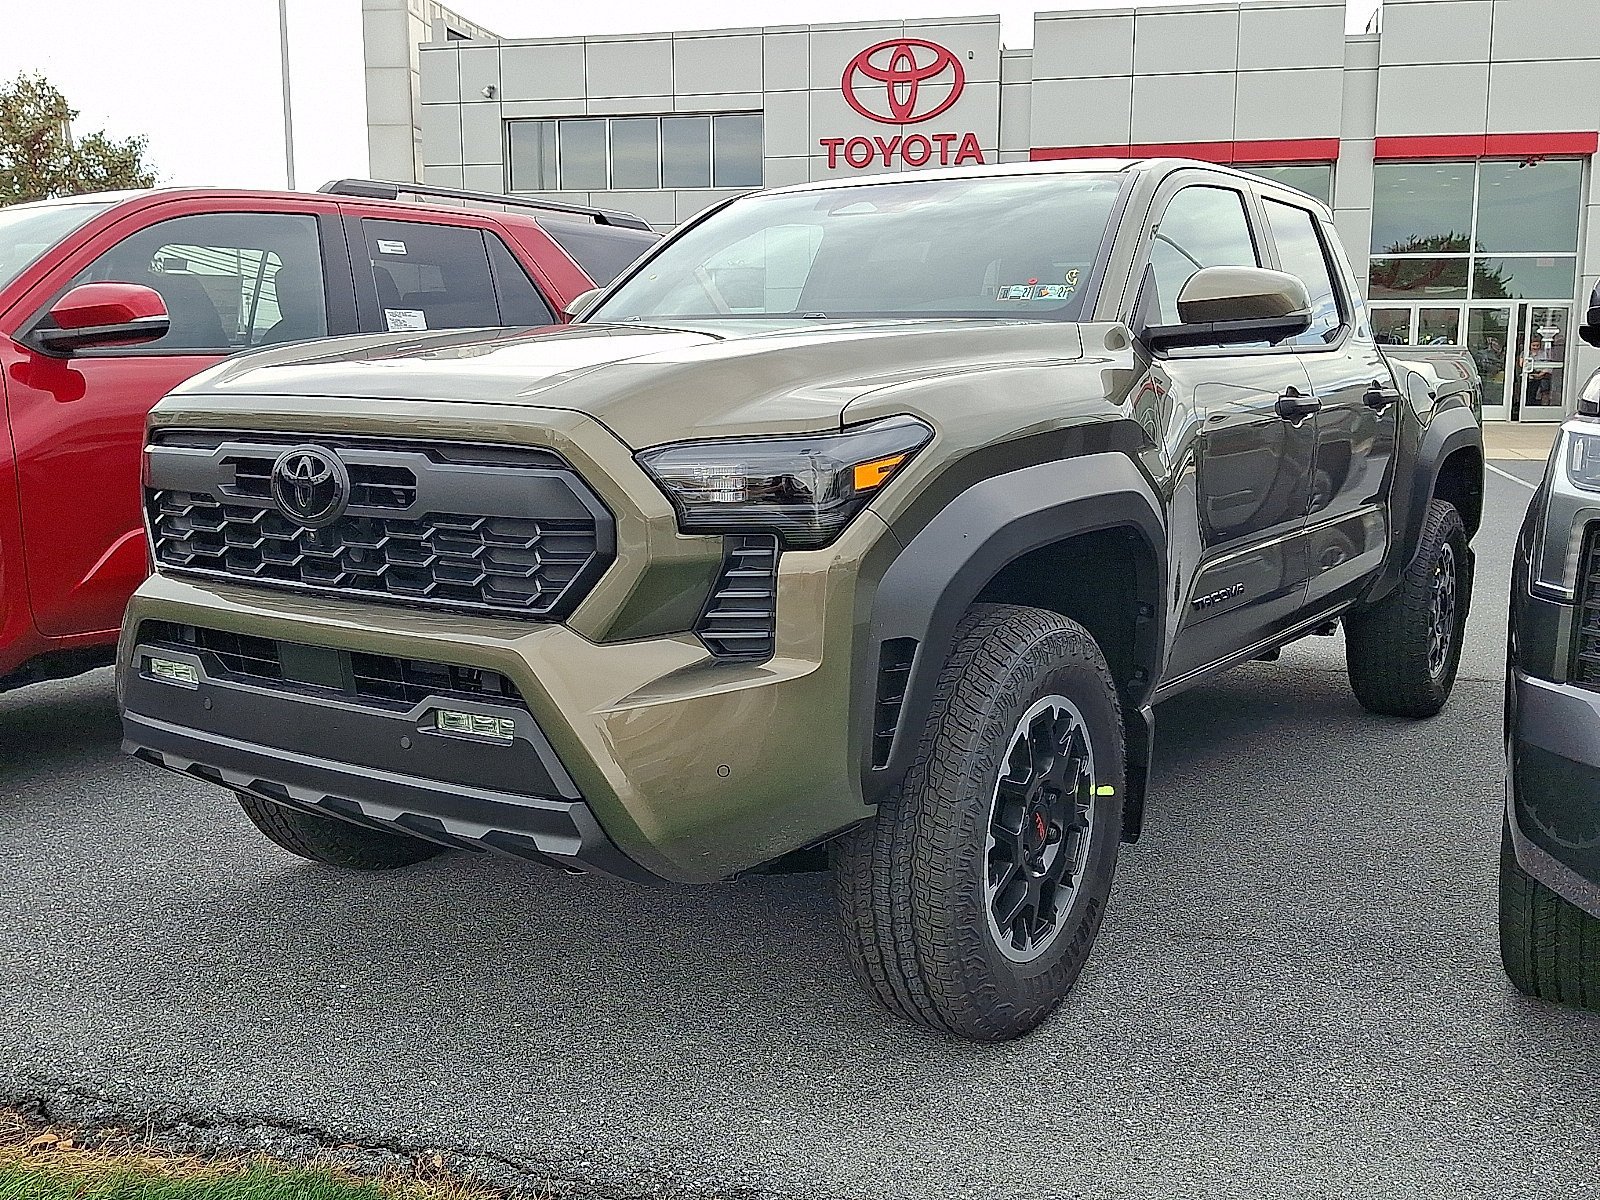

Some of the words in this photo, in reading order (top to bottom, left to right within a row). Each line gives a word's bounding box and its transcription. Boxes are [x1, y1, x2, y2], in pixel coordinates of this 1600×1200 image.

[820, 133, 985, 168] TOYOTA
[1021, 287, 1032, 298] 27
[1191, 582, 1244, 610] TACOMA
